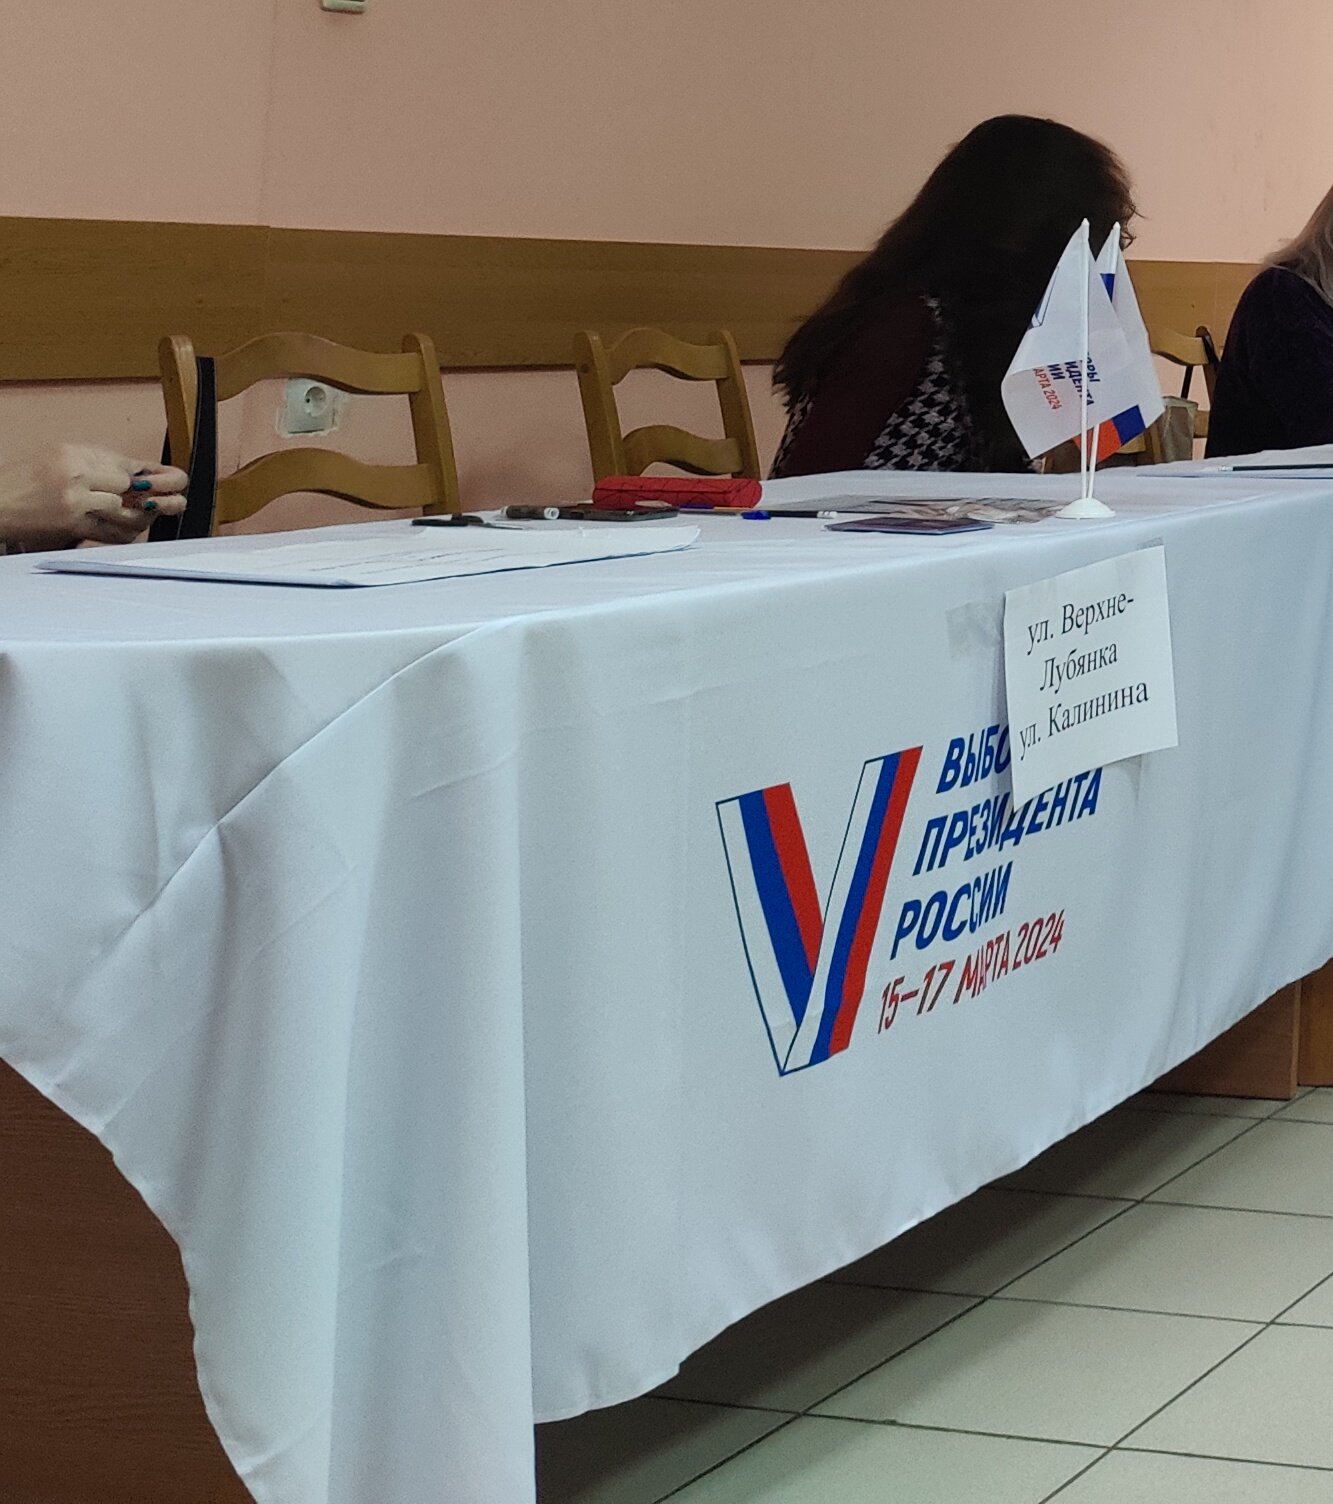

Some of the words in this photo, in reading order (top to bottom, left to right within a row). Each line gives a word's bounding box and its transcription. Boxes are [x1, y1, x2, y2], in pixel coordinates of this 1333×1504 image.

[1032, 368, 1052, 390] АРТА
[1027, 619, 1054, 656] ул.
[1061, 593, 1134, 635] Верхне-
[1039, 643, 1118, 695] Лубянка
[1019, 723, 1042, 761] ул.
[1048, 682, 1150, 738] Калинина
[936, 724, 1011, 794] ВЫБО
[912, 767, 1103, 876] ПРЕЗИДЕНТА
[889, 860, 1013, 961] РОССИИ
[953, 930, 1011, 1005] МАРТА
[1012, 908, 1065, 971] 2024
